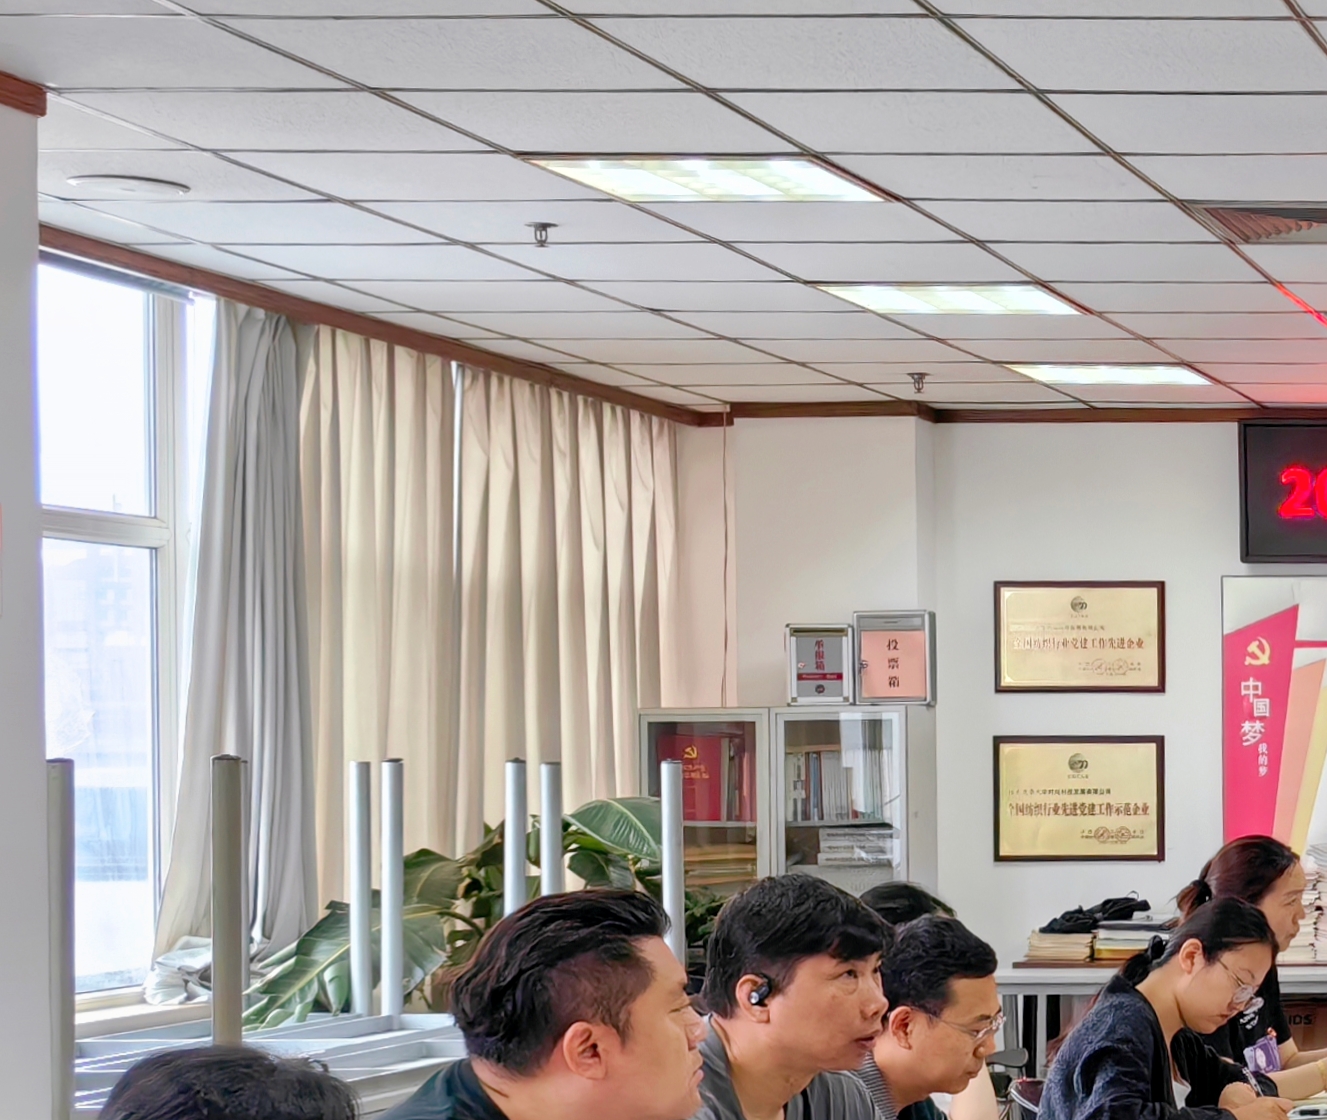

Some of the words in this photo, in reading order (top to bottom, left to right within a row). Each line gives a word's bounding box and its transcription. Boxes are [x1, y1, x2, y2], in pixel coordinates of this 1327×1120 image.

[886, 638, 900, 688] 投票箱
[1240, 676, 1271, 746] 中国梦
